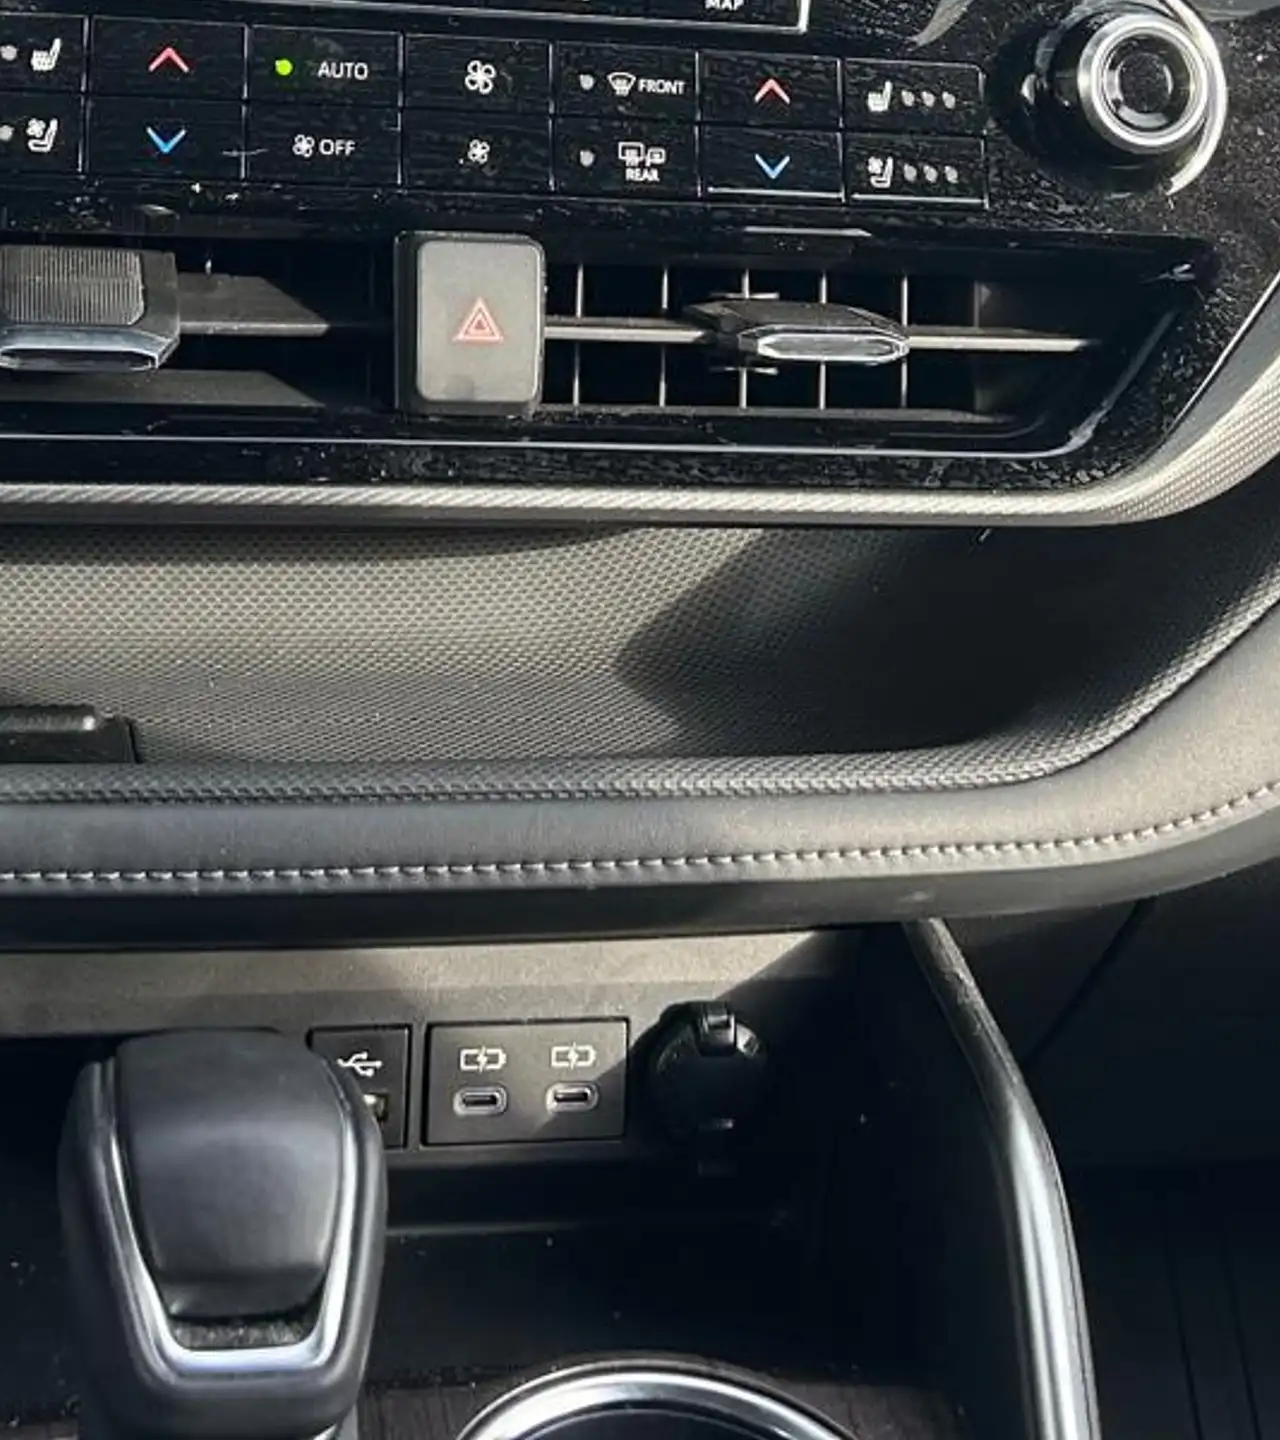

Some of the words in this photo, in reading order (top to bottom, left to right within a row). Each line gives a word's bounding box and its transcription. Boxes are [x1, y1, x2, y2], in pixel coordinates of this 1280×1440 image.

[316, 59, 369, 82] AUTO
[637, 75, 686, 98] FRONT
[318, 136, 357, 158] OFF
[624, 166, 661, 184] REAR
